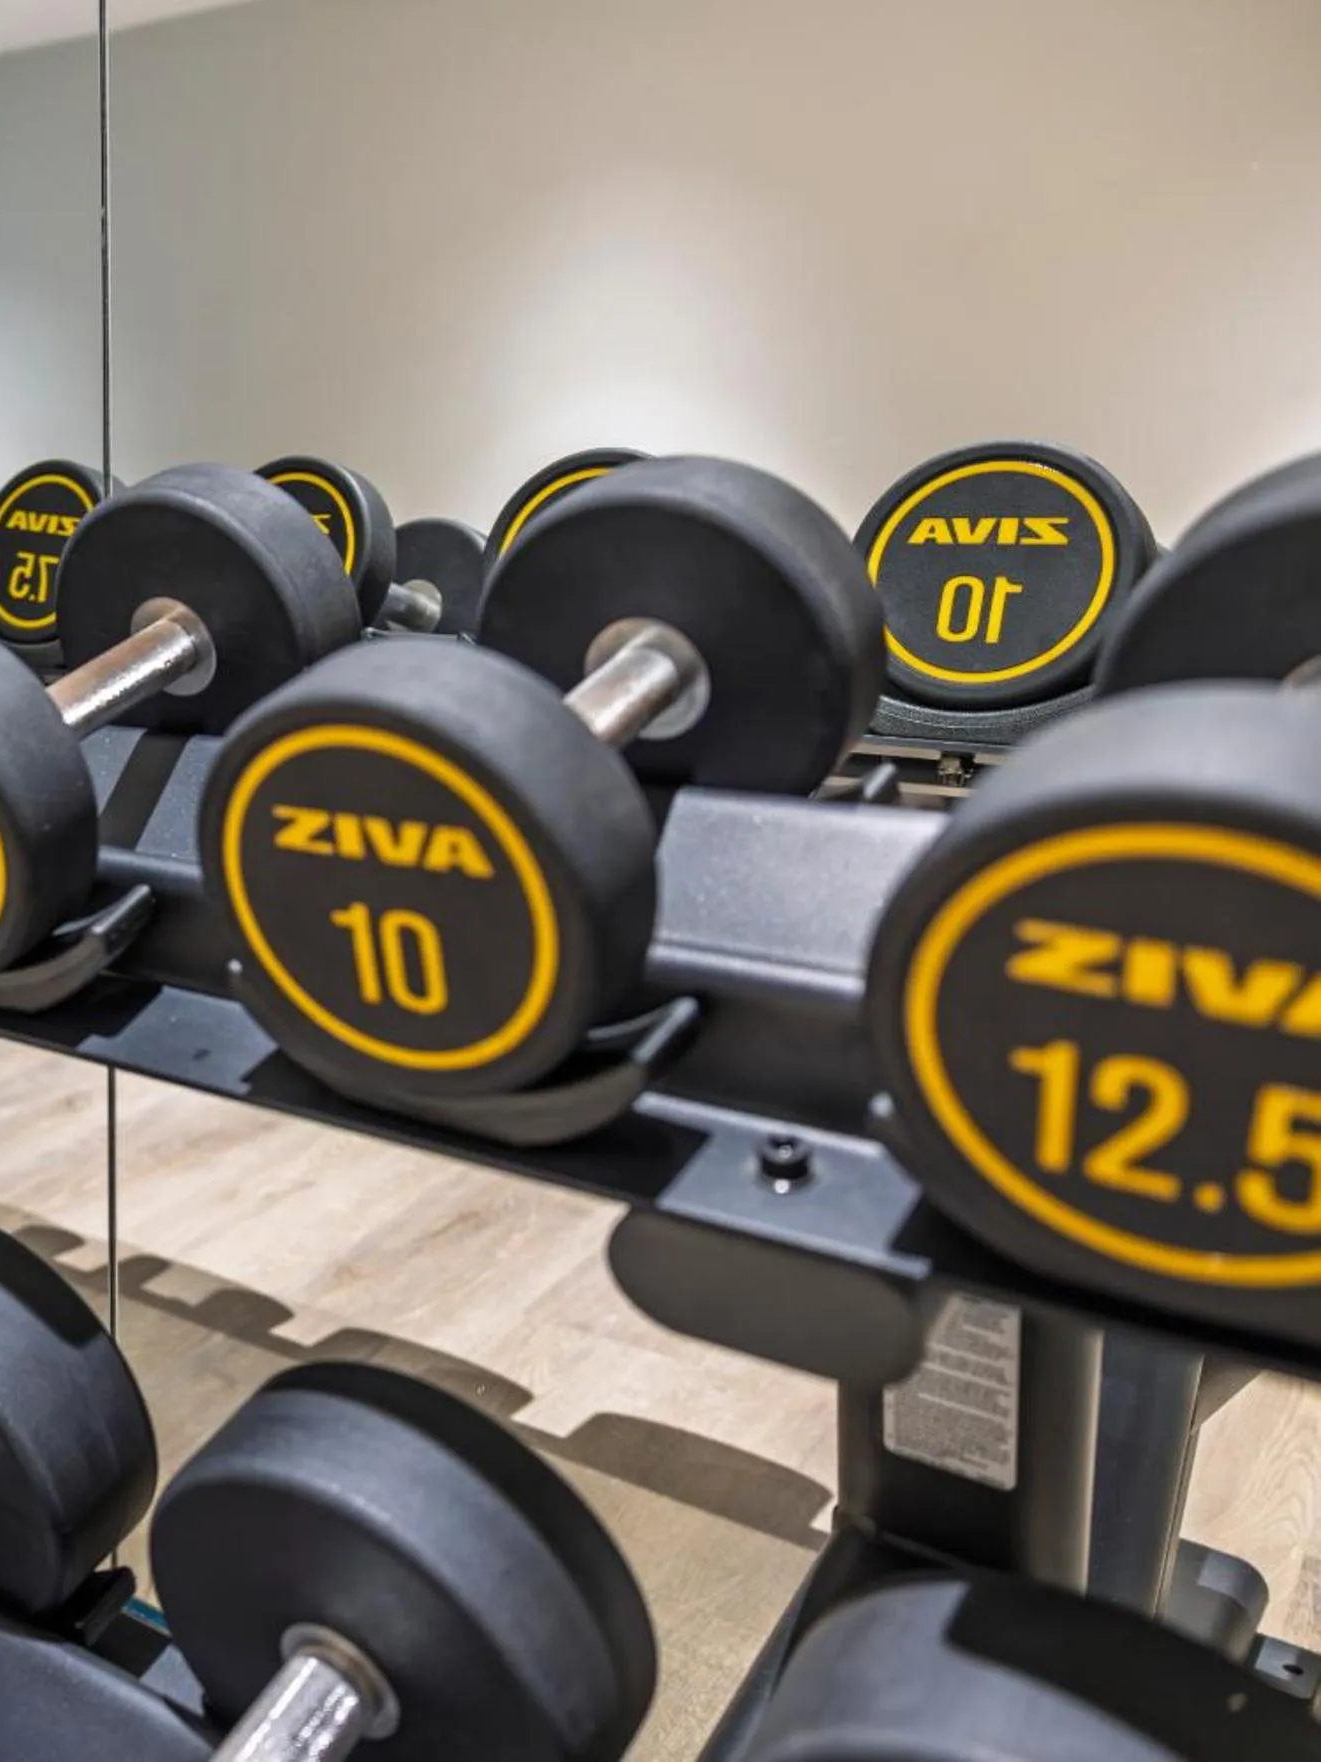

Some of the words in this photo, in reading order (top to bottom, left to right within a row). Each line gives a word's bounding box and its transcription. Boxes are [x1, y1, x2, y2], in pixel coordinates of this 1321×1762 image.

[271, 803, 496, 880] ZIVA
[329, 900, 449, 1017] 10
[1007, 1038, 1321, 1236] 12.5
